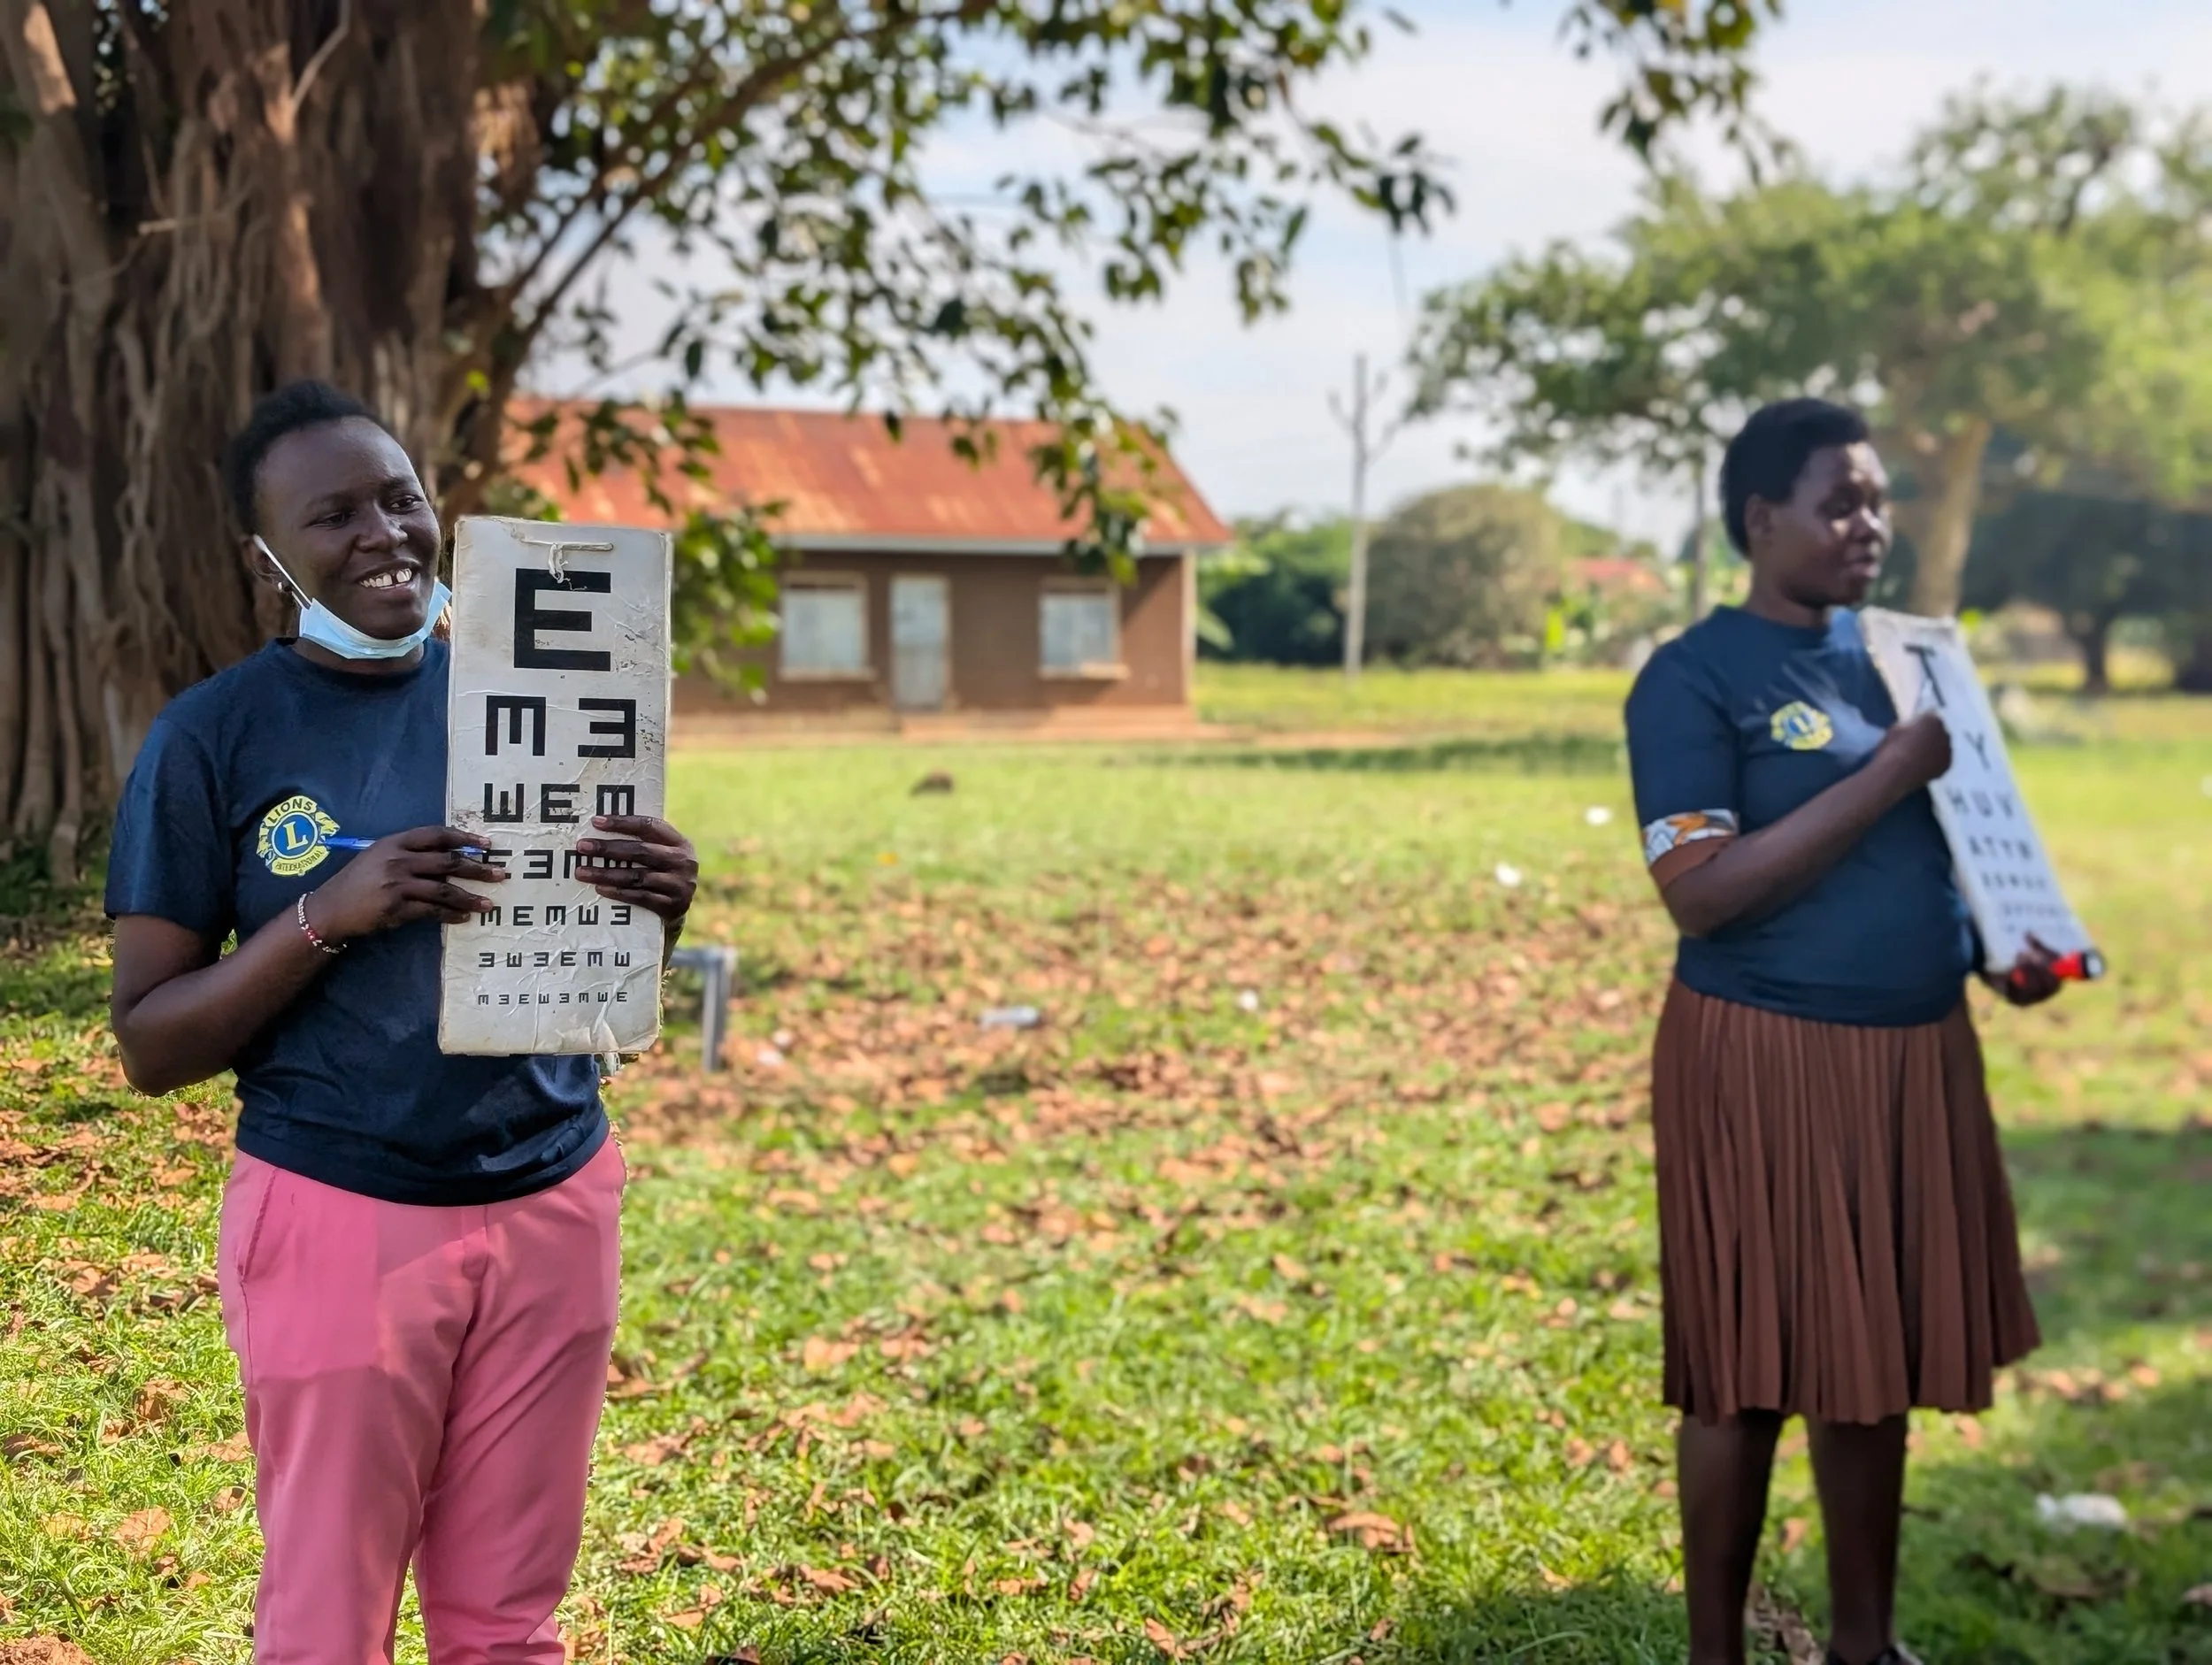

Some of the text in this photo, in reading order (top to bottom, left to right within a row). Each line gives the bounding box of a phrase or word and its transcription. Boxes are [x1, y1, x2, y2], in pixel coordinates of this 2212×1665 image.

[514, 568, 611, 671] E
[1902, 642, 1946, 707] T
[1963, 729, 1991, 770] Y
[267, 798, 313, 824] LIONS
[283, 821, 309, 850] L
